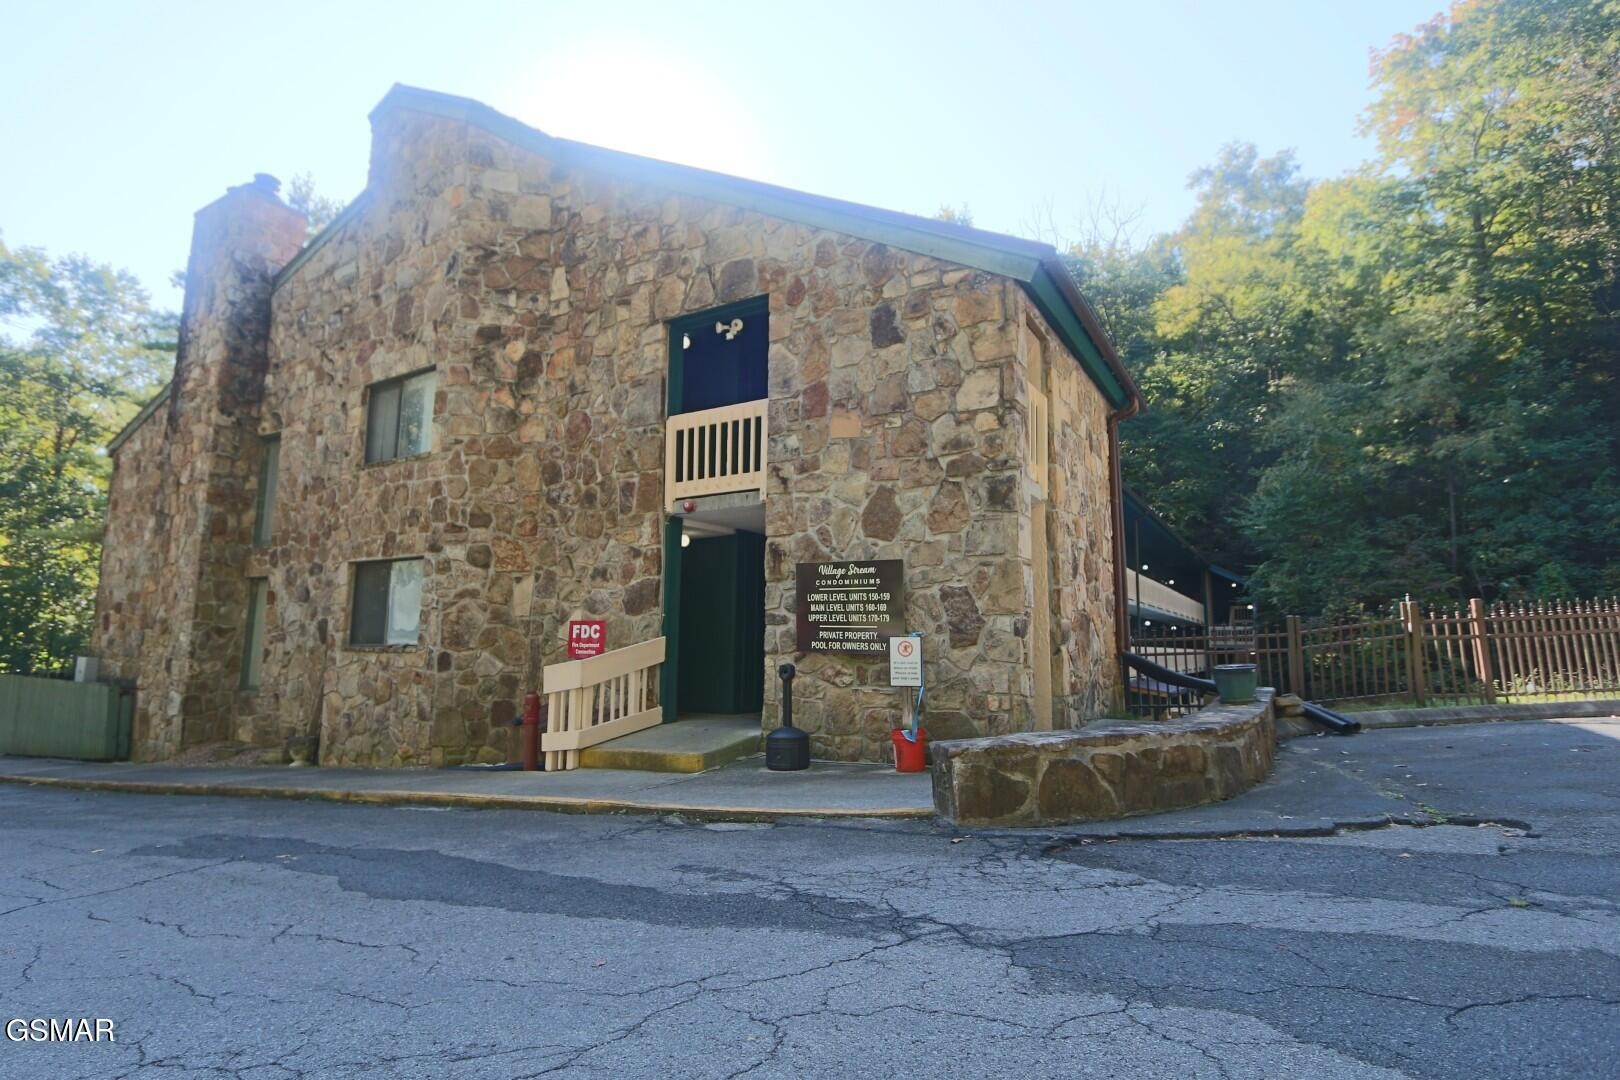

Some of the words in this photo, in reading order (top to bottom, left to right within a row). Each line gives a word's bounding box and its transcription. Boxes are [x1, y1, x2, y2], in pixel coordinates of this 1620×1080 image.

[819, 564, 846, 579] Village
[848, 564, 876, 575] Stream
[807, 593, 828, 602] LOWER
[829, 593, 848, 601] LEVEL
[849, 592, 867, 601] UNITS
[868, 592, 891, 601] 150-159
[810, 603, 825, 612] MAIN
[826, 603, 845, 612] LEVEL
[845, 603, 864, 612] UNITS
[865, 603, 887, 612] 160-169
[808, 614, 828, 622] UPPER
[828, 614, 848, 622] LEVEL
[848, 614, 867, 622] UNITS
[868, 614, 890, 622] 170-179
[572, 624, 601, 639] FDC
[819, 631, 843, 640] PRIVATE
[844, 631, 878, 640] PROPERTY
[811, 641, 827, 650] POOL
[828, 641, 841, 650] FOR
[842, 642, 869, 650] OWNERS
[869, 642, 887, 651] ONLY
